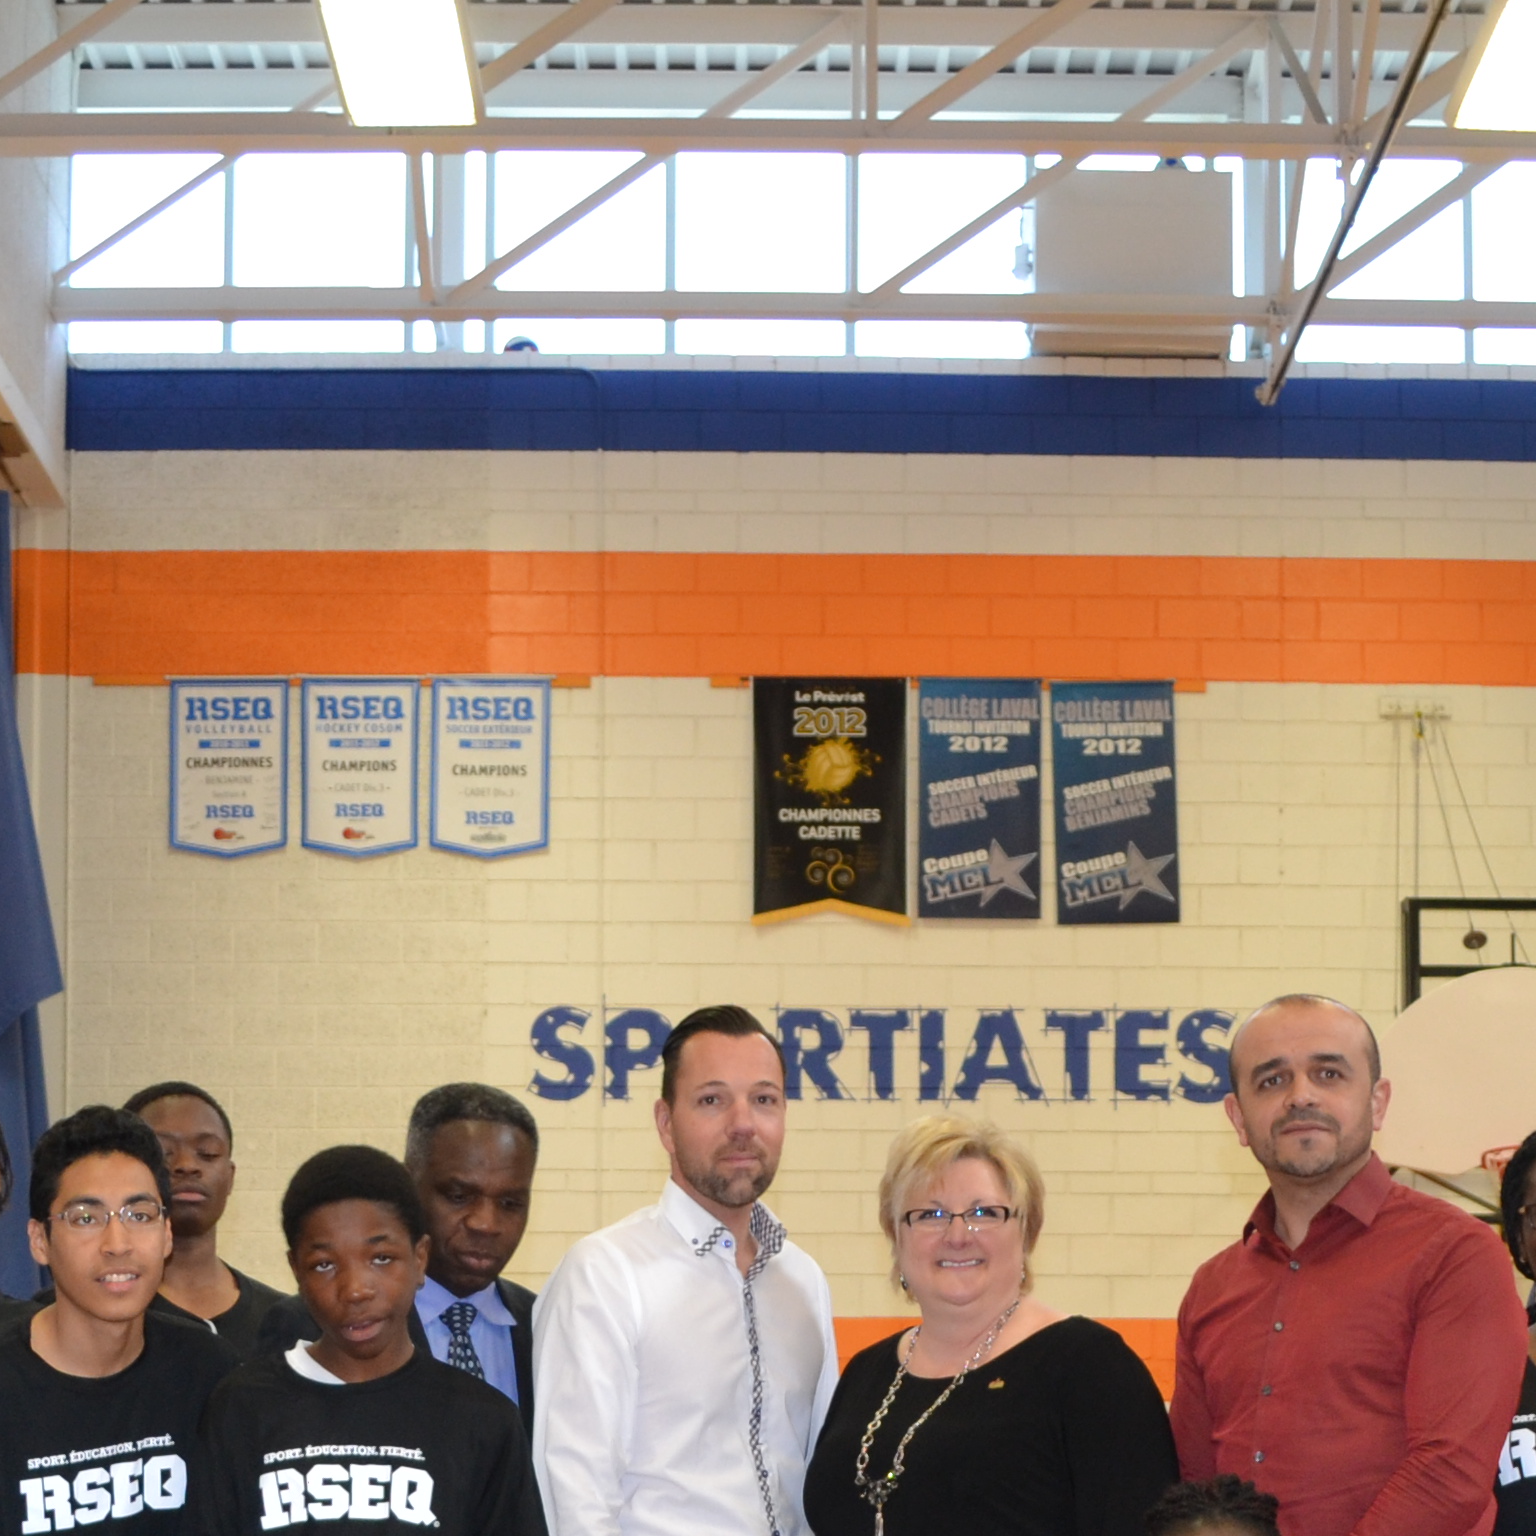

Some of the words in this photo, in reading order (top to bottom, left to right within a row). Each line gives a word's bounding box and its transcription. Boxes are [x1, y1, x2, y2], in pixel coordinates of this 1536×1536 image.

[316, 696, 405, 720] RSEQ
[795, 690, 811, 702] Le
[922, 695, 988, 719] COLLÈGE
[992, 698, 1040, 720] LAVAL
[185, 697, 274, 721] RSEQ
[446, 696, 536, 721] RSEQ
[1054, 697, 1122, 722] COLLÈGE
[1125, 700, 1172, 722] LAVAL
[186, 725, 272, 734] VOLLEYBALL
[316, 723, 360, 733] HOCKEY
[365, 723, 402, 733] COSOM
[446, 725, 479, 734] SOCCER
[793, 706, 867, 737] 2012
[949, 736, 1008, 752] 2012
[1082, 738, 1142, 755] 2012
[186, 757, 273, 768] CHAMPIONNES
[322, 760, 397, 772] CHAMPIONS
[452, 764, 527, 776] CHAMPIONS
[928, 776, 976, 795] SOCCER
[976, 764, 1038, 786] INTÉRIEUR
[1063, 779, 1112, 800] SOCCER
[1111, 766, 1173, 790] INTÉRIEUR
[928, 782, 1020, 811] CHAMPIONS
[1064, 783, 1156, 816] CHAMPIONS
[205, 805, 255, 818] RSEQ
[335, 803, 384, 817] RSEQ
[465, 811, 515, 825] RSEQ
[779, 808, 881, 822] CHAMPIONNES
[929, 803, 988, 828] CADETS
[799, 826, 861, 839] CADETTE
[924, 849, 988, 874] Coupe
[1061, 851, 1127, 878] Coupe
[528, 1001, 1236, 1106] SPRTIATES
[27, 1456, 69, 1470] SPORT.
[70, 1442, 136, 1464] ÉDUCATION.
[264, 1448, 304, 1464] SPORT.
[305, 1444, 379, 1457] ÉDUCATION.
[380, 1446, 426, 1461] FIERTÉ.
[19, 1454, 187, 1535] RSEQ
[259, 1464, 437, 1531] RSEQ
